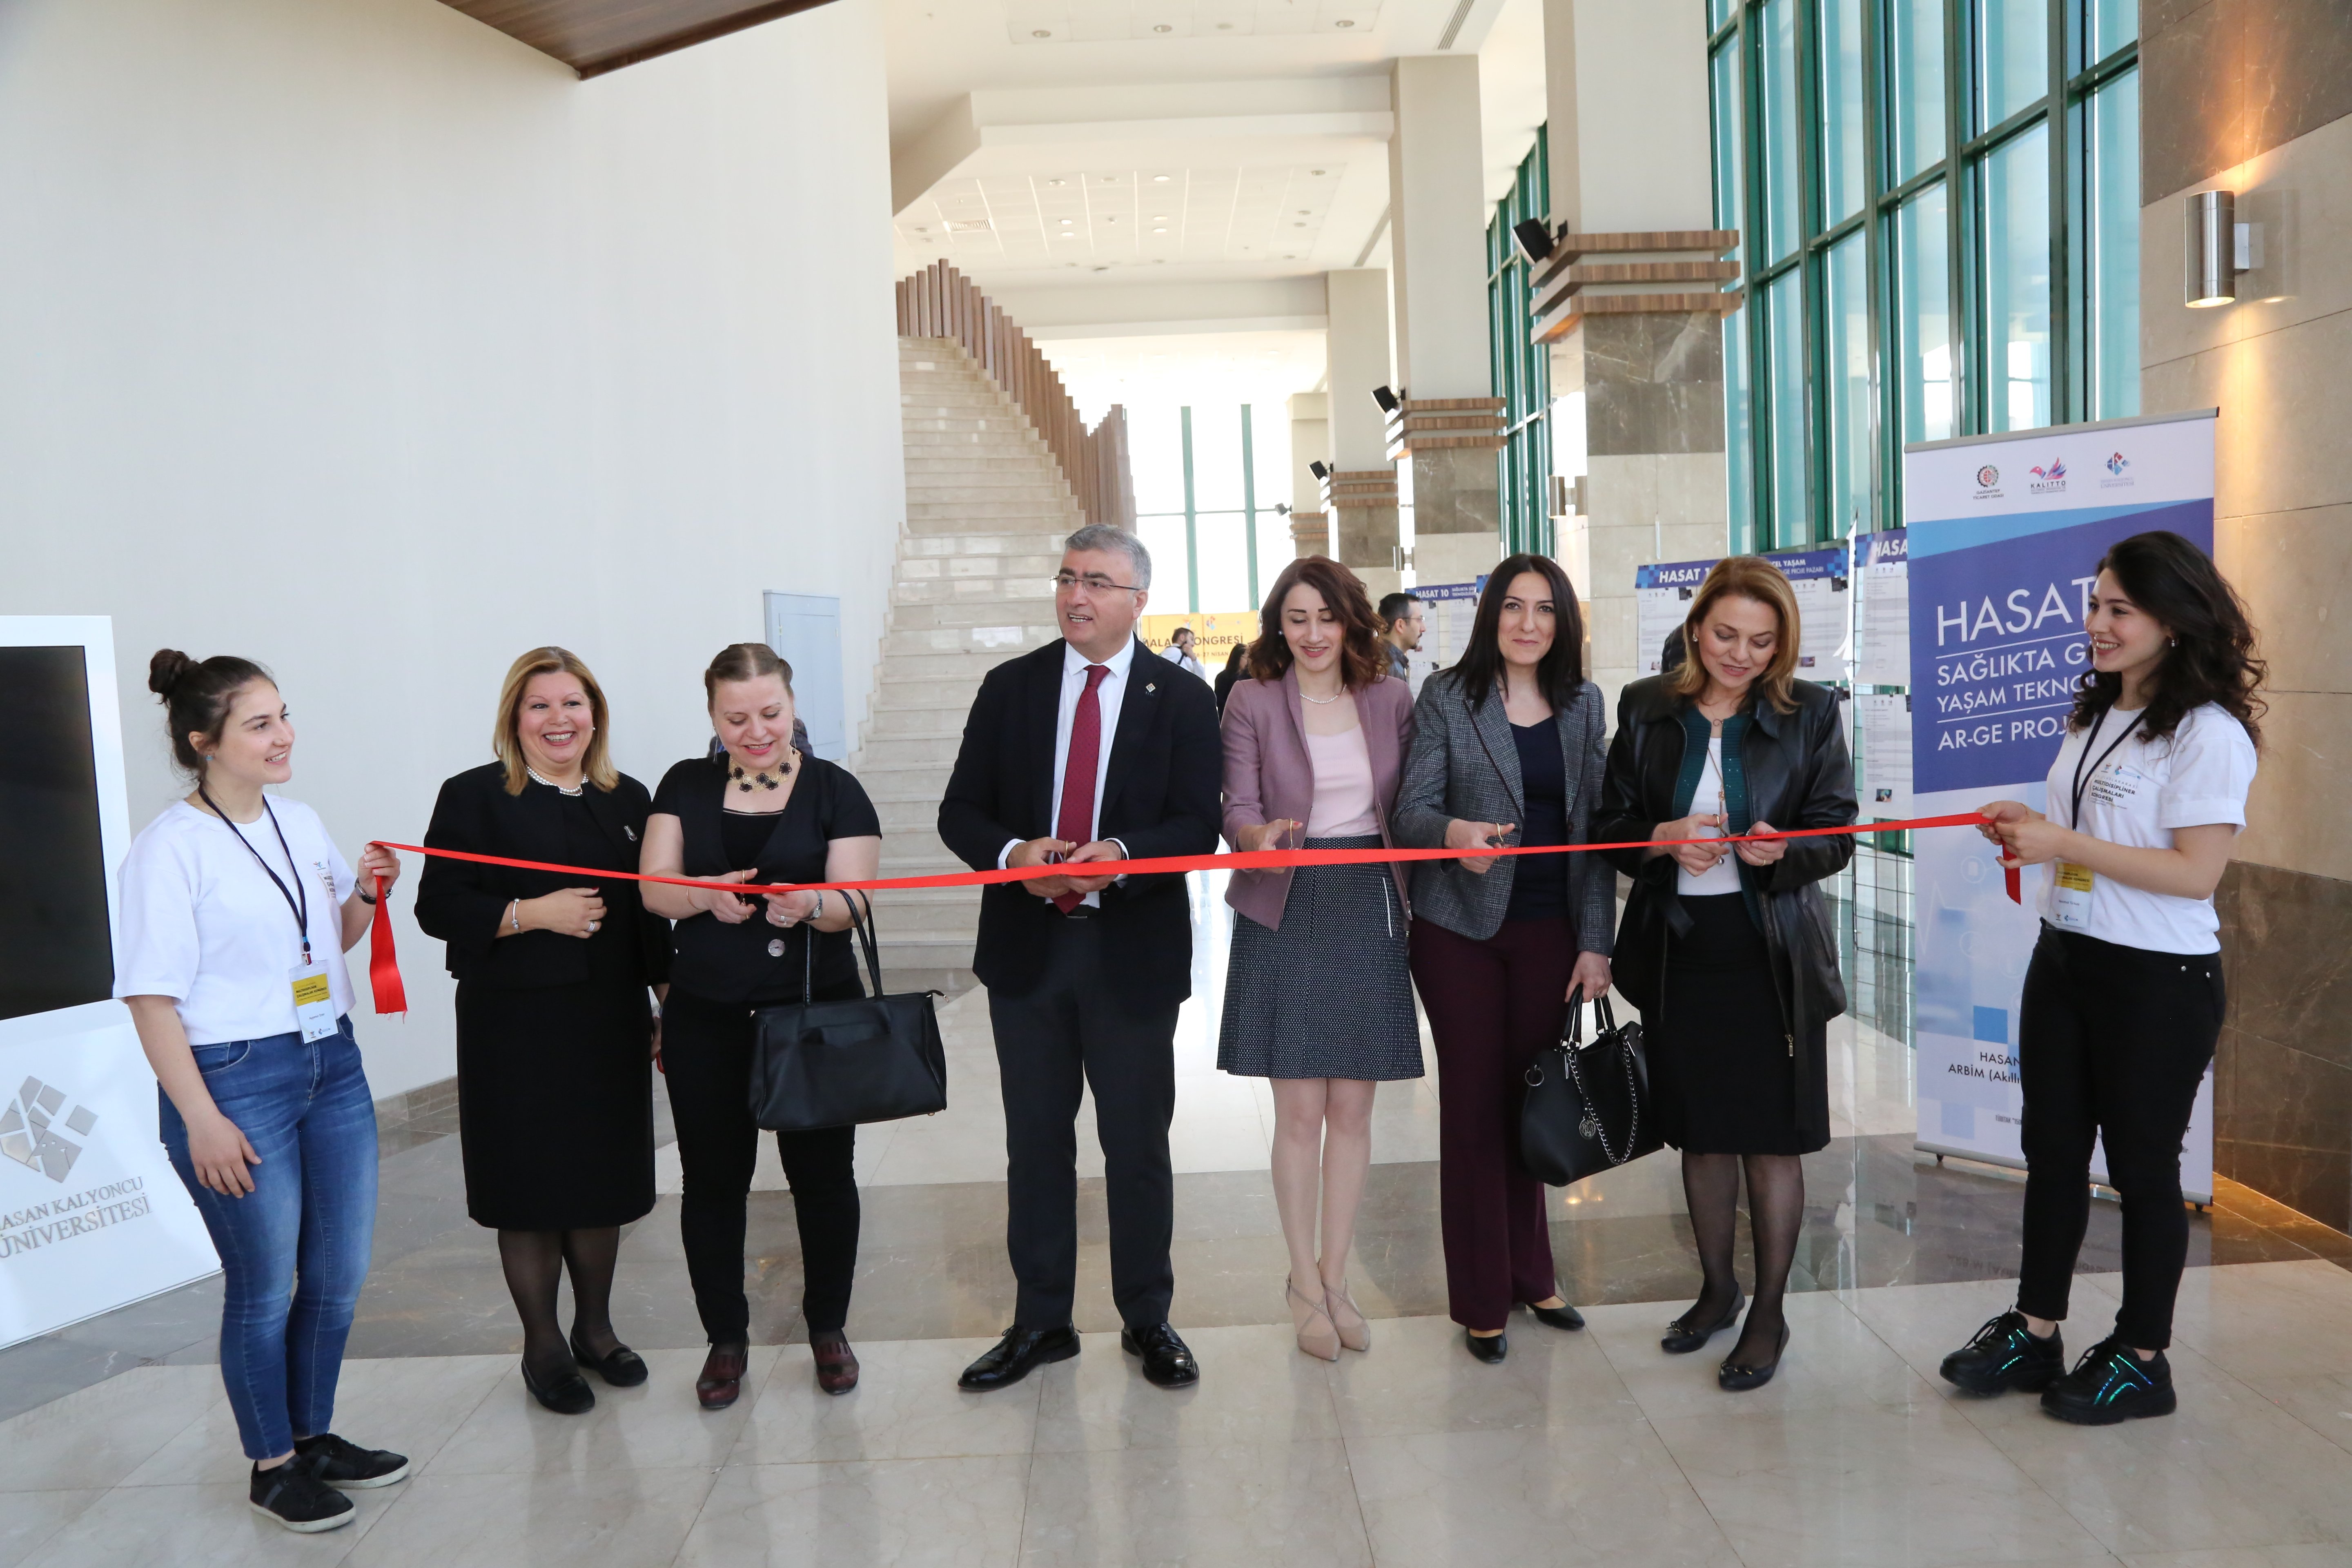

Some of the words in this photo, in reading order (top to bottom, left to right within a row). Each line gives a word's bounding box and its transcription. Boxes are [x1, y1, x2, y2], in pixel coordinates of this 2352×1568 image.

[1875, 538, 1908, 557] HASA
[1659, 568, 1701, 584] HASAT
[1416, 590, 1439, 599] HASAT
[1441, 589, 1449, 597] 10
[1938, 575, 2097, 646] HASAT
[1194, 633, 1243, 646] ONGRESİ
[1938, 650, 2056, 686] SAĞLIKTA
[1937, 686, 2006, 714] YAŞAM
[1938, 724, 2002, 751] AR-GE
[2011, 715, 2068, 742] PROJ
[1980, 1051, 2020, 1067] HASAN
[1948, 1064, 1984, 1078] ARBİM
[0, 1203, 49, 1231] ASAN
[51, 1176, 143, 1215] KALYONCU
